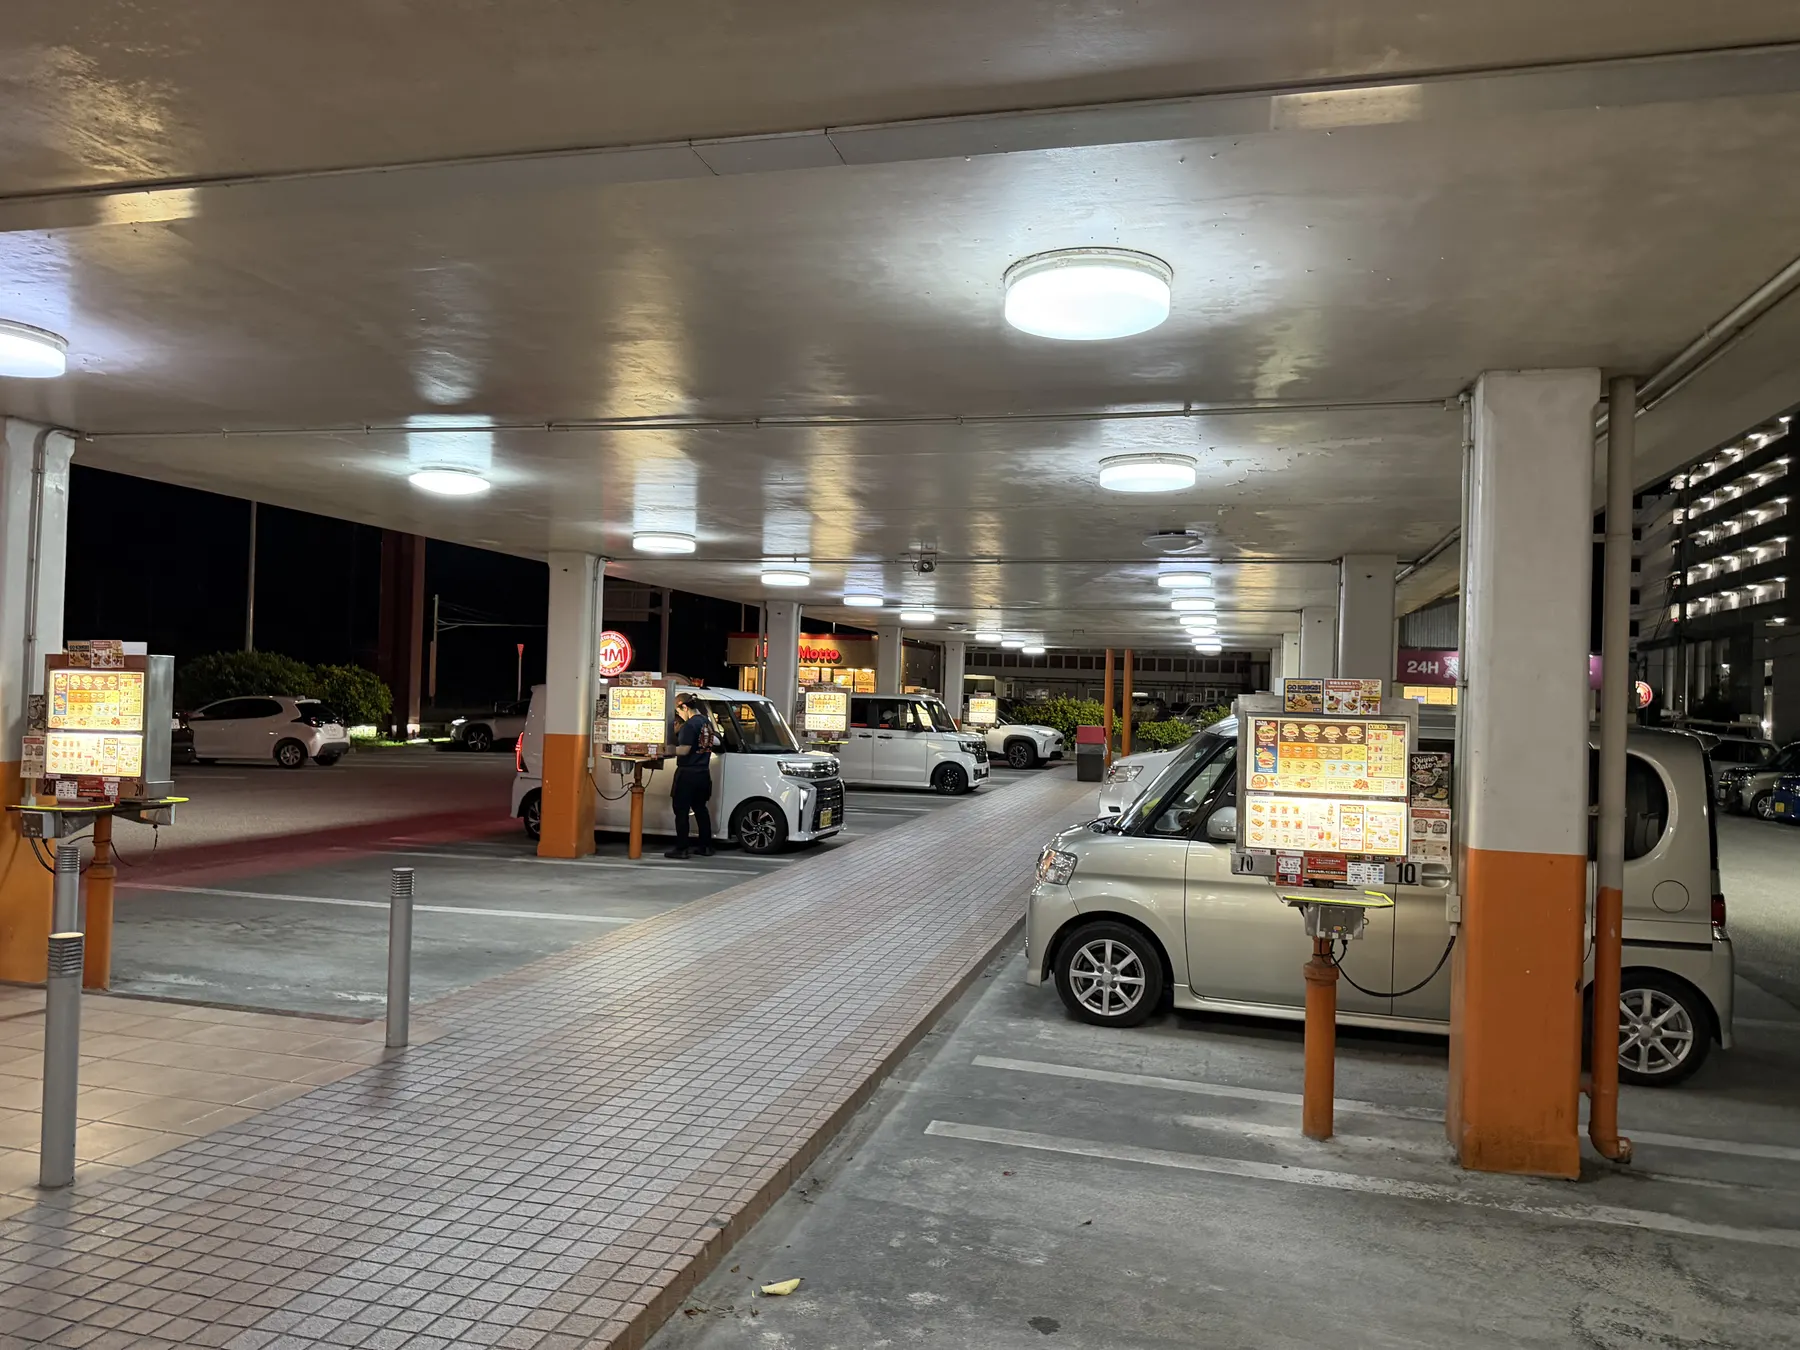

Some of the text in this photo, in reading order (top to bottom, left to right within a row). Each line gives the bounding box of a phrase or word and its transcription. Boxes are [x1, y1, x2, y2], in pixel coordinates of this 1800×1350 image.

[799, 646, 840, 659] Motto
[1406, 660, 1439, 674] 24H
[43, 779, 55, 795] 20
[135, 785, 144, 796] 20
[1240, 855, 1253, 872] 10
[1396, 863, 1416, 883] 10
